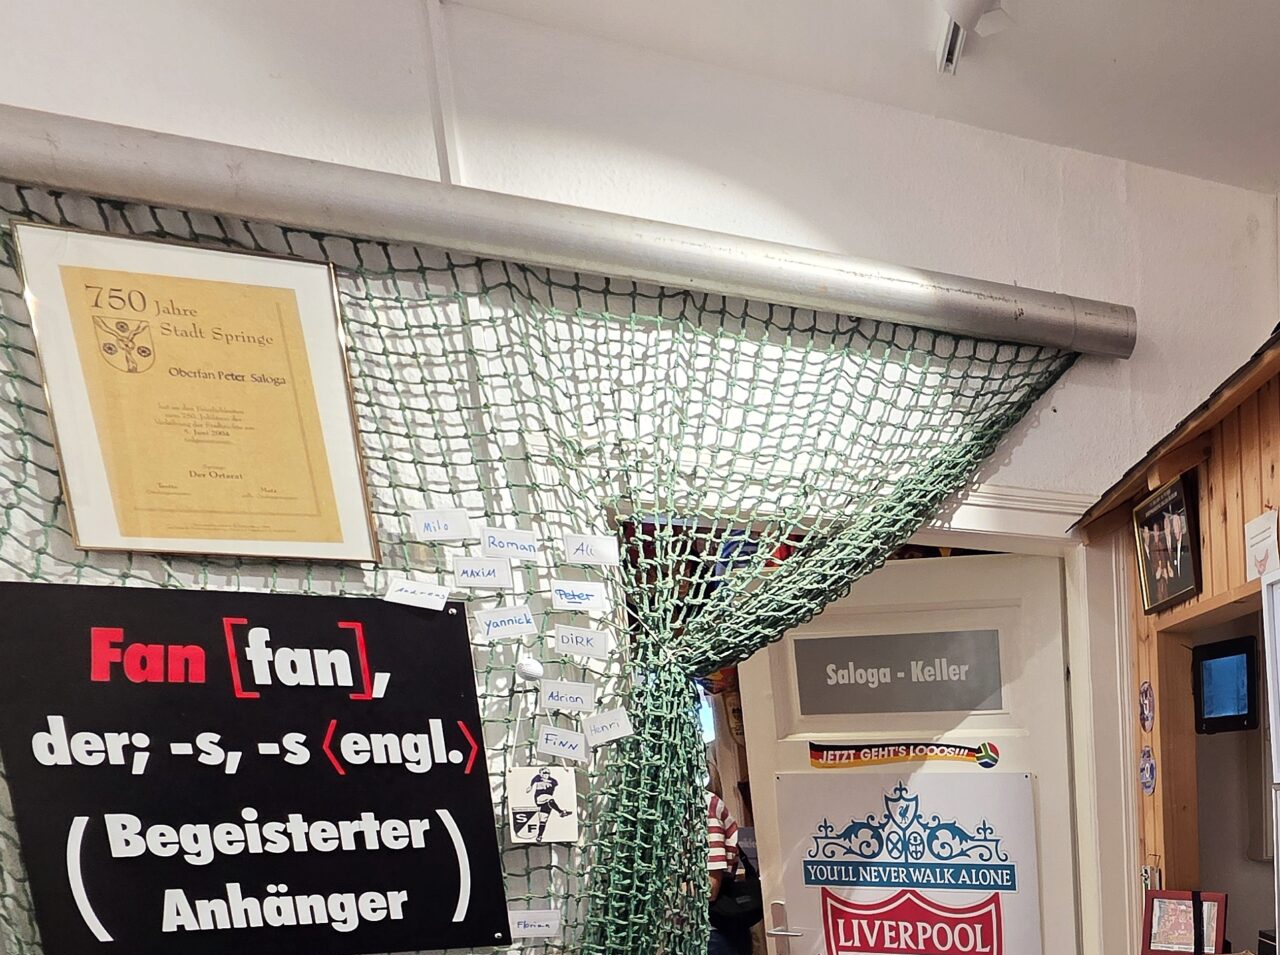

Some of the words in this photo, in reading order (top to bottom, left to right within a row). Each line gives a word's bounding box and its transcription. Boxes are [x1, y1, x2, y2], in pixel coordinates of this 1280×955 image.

[84, 284, 147, 312] 750
[153, 300, 198, 318] Jahre
[160, 322, 206, 340] Stadt
[212, 327, 274, 347] Springe
[218, 370, 246, 382] Peter
[250, 372, 287, 387] Saloga
[188, 470, 206, 479] Der
[423, 518, 449, 534] Milo
[488, 535, 536, 553] Roman
[554, 588, 595, 601] Peter
[89, 626, 206, 683] Fan
[826, 662, 891, 688] Saloga
[910, 658, 969, 682] Keller
[548, 691, 584, 705] Adrian
[589, 721, 620, 735] Henri
[31, 715, 151, 775] der;
[169, 729, 243, 775] -s,
[256, 730, 311, 765] -s
[819, 749, 855, 764] JETZT
[860, 745, 907, 761] GEHT'S
[516, 813, 528, 823] S
[104, 807, 430, 866] Begeisterter
[527, 824, 537, 833] F
[807, 865, 857, 882] YOU'LL
[859, 867, 909, 883] NEVER
[908, 868, 959, 884] WALK
[958, 870, 1012, 886] ALONE
[161, 882, 409, 933] Anhänger
[836, 918, 991, 953] LIVERPOOL
